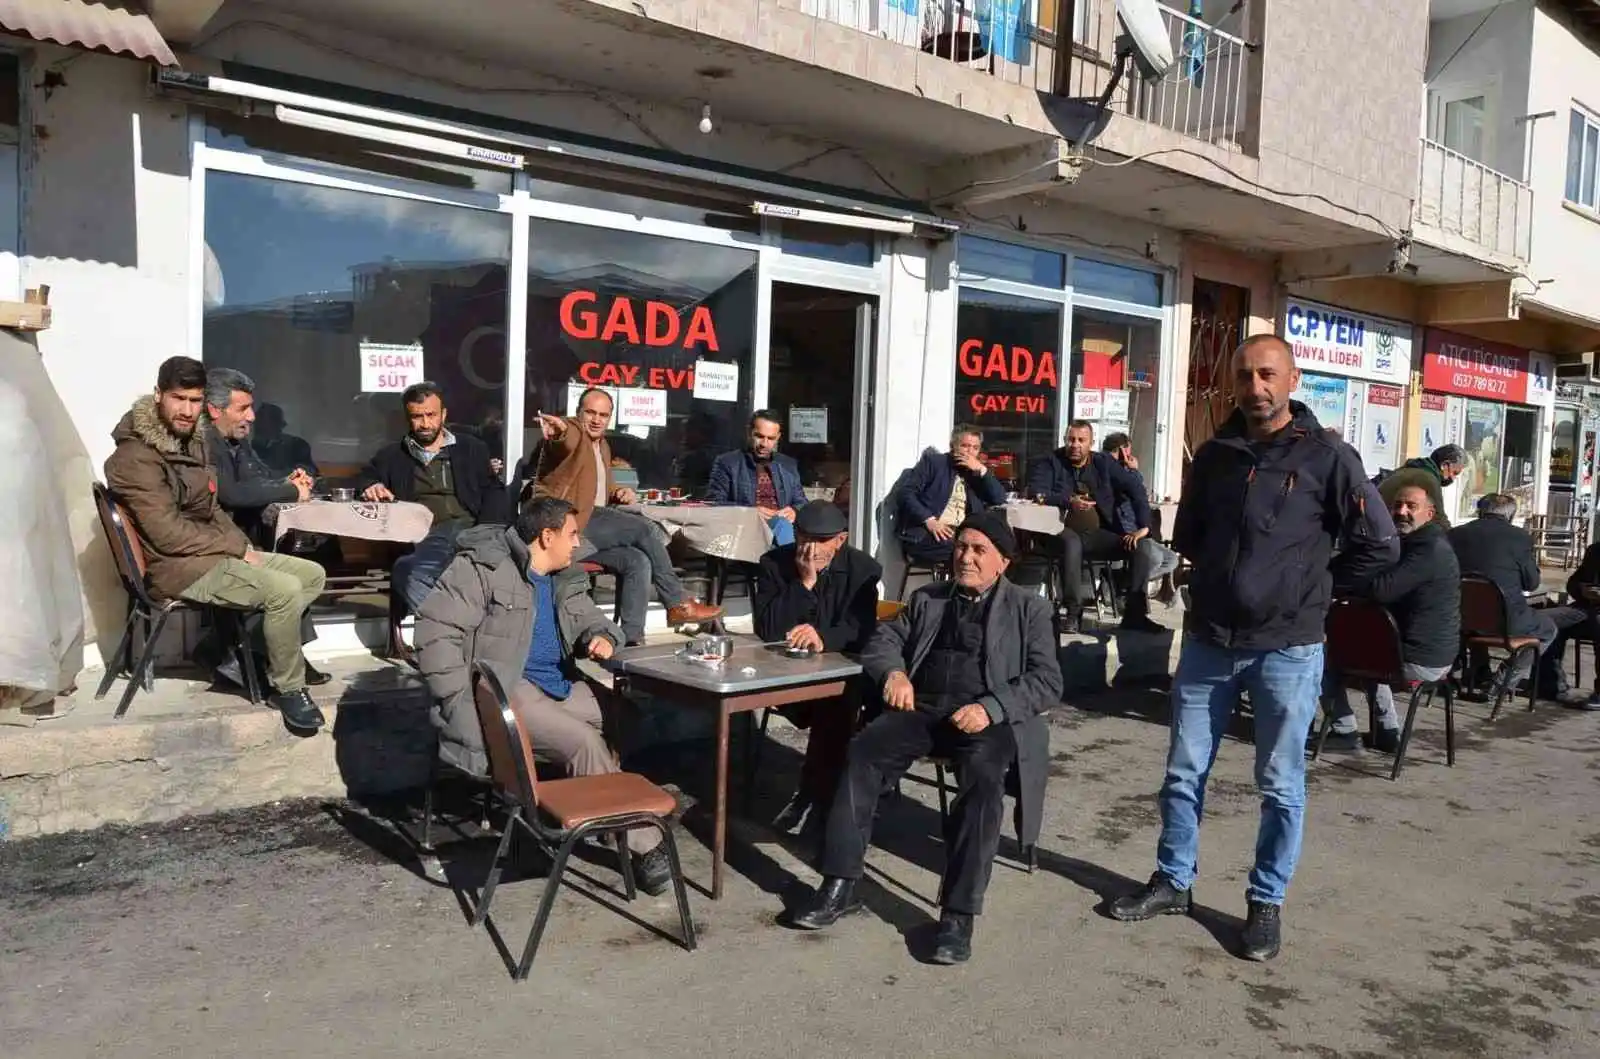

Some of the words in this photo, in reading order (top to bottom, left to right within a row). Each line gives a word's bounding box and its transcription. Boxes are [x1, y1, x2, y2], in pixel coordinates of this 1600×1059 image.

[560, 290, 719, 351] GADA
[368, 354, 416, 368] SICAK
[960, 338, 1057, 389] GADA
[1328, 347, 1363, 369] LİDERİ
[1438, 343, 1470, 370] ATICI
[1473, 345, 1520, 379] TİCARET
[378, 371, 408, 388] SÜT
[580, 362, 640, 389] ÇAY
[650, 364, 695, 391] EVİ
[1453, 372, 1472, 387] 0537
[971, 394, 1009, 415] ÇAY
[1015, 394, 1045, 414] EVİ
